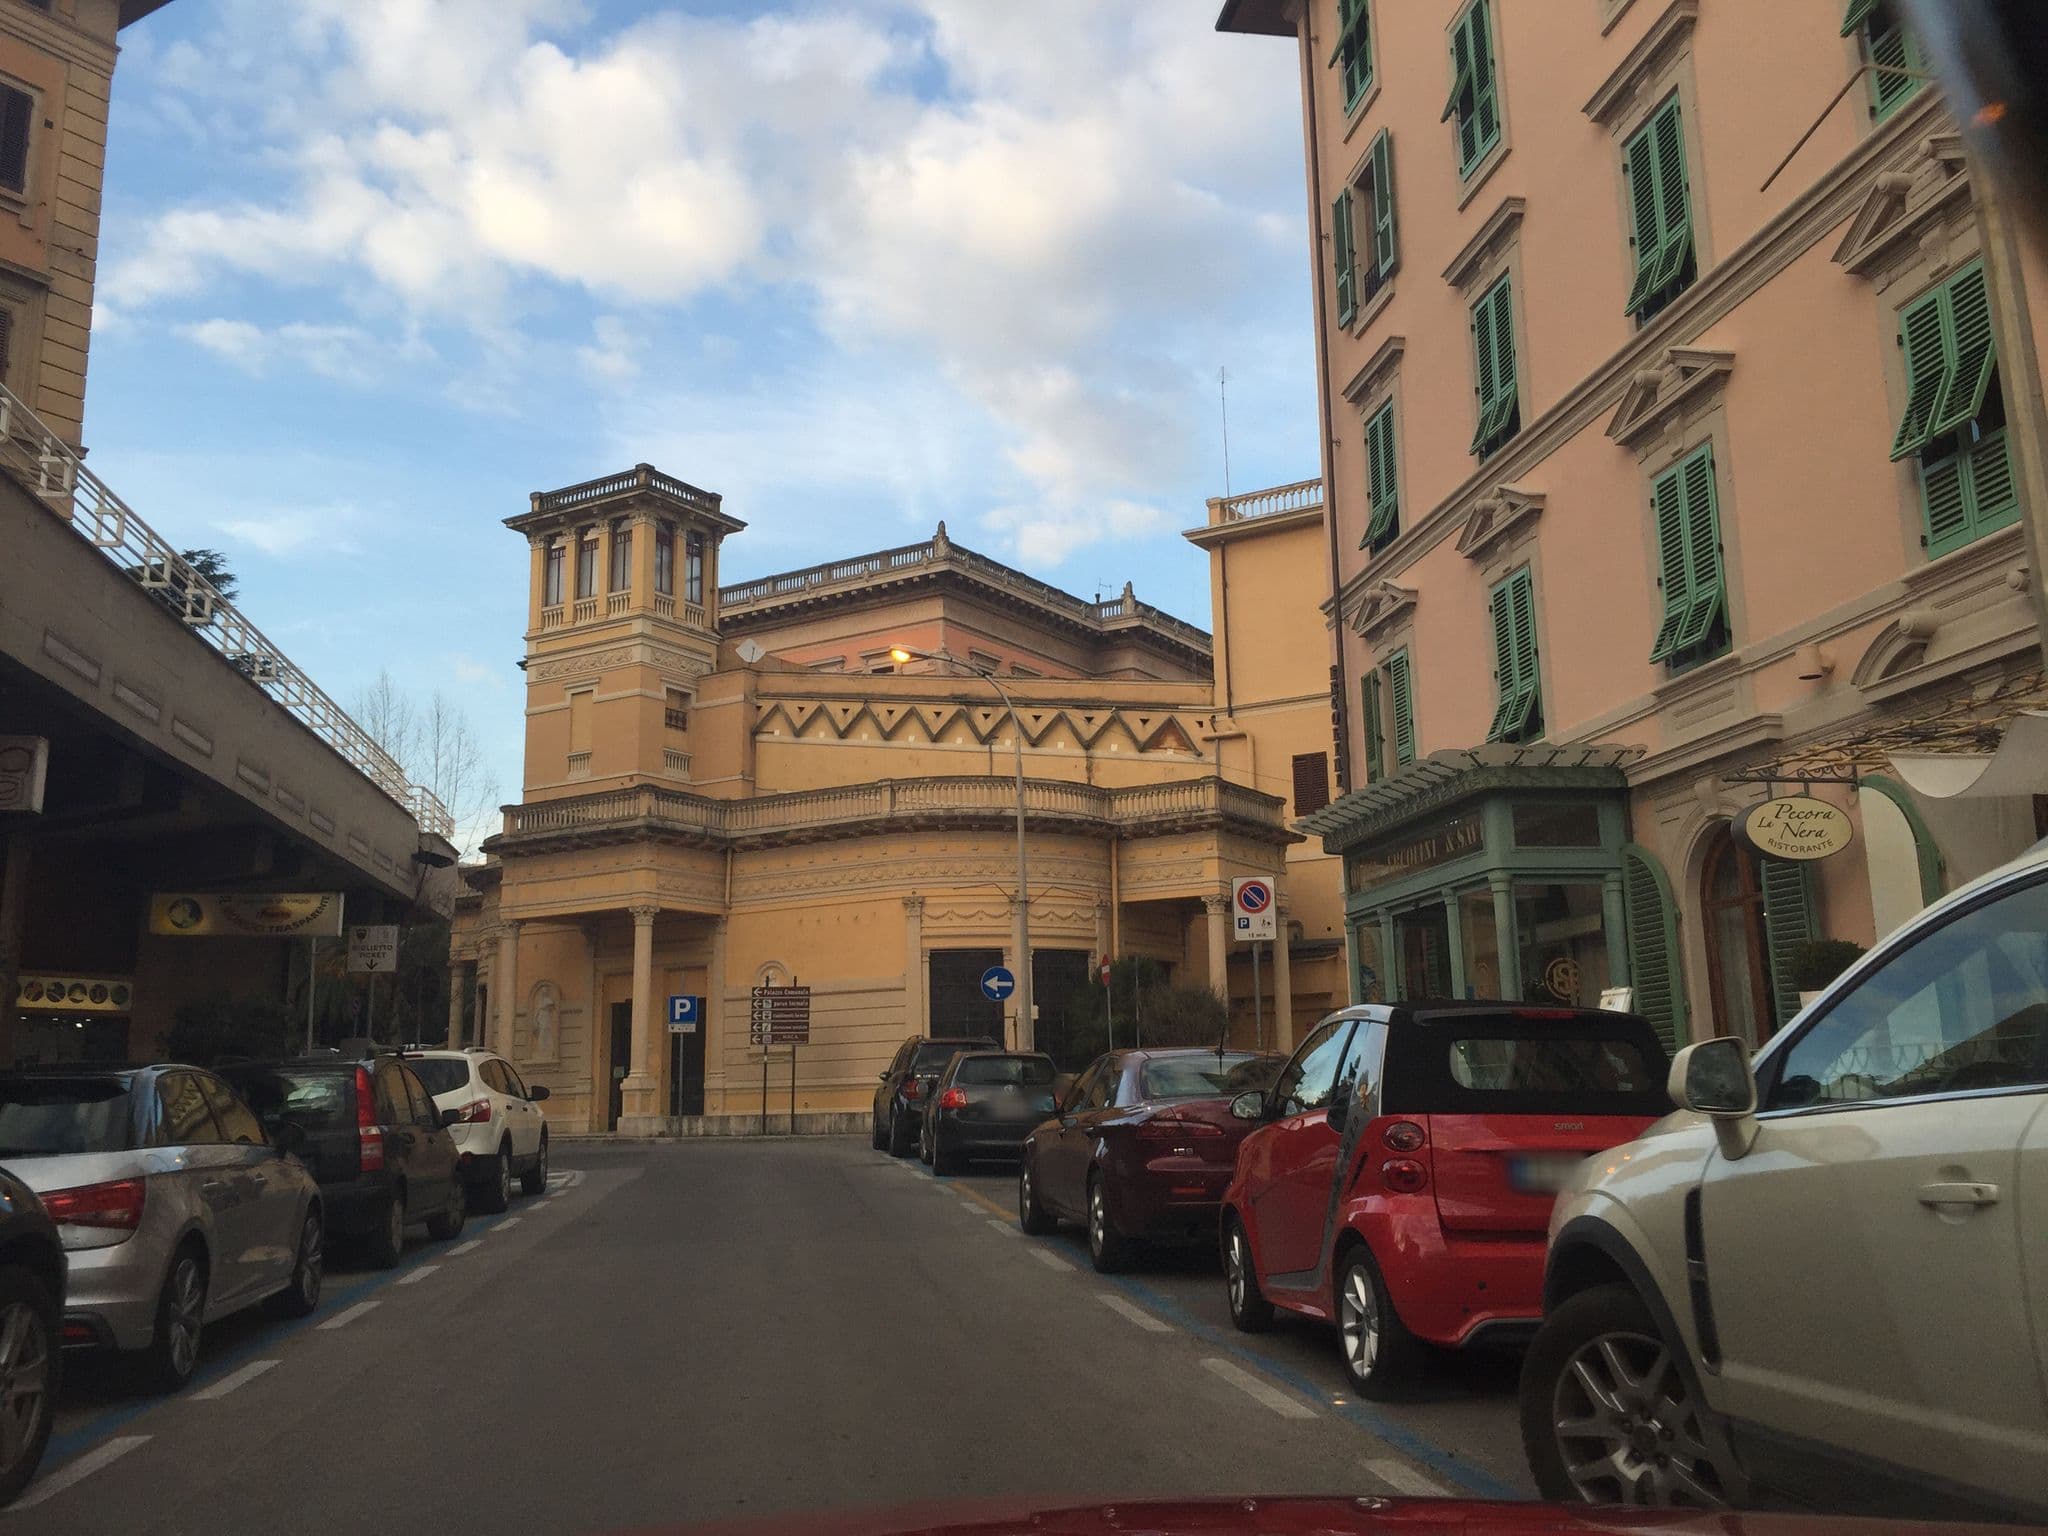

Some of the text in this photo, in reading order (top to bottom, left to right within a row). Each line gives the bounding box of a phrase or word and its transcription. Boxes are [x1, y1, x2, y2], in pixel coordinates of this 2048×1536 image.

[1774, 803, 1834, 820] Pecora
[1757, 816, 1774, 829] La
[1780, 821, 1828, 840] Nera
[1767, 838, 1834, 853] RISTORANTE
[1240, 919, 1248, 928] P
[674, 998, 691, 1020] P
